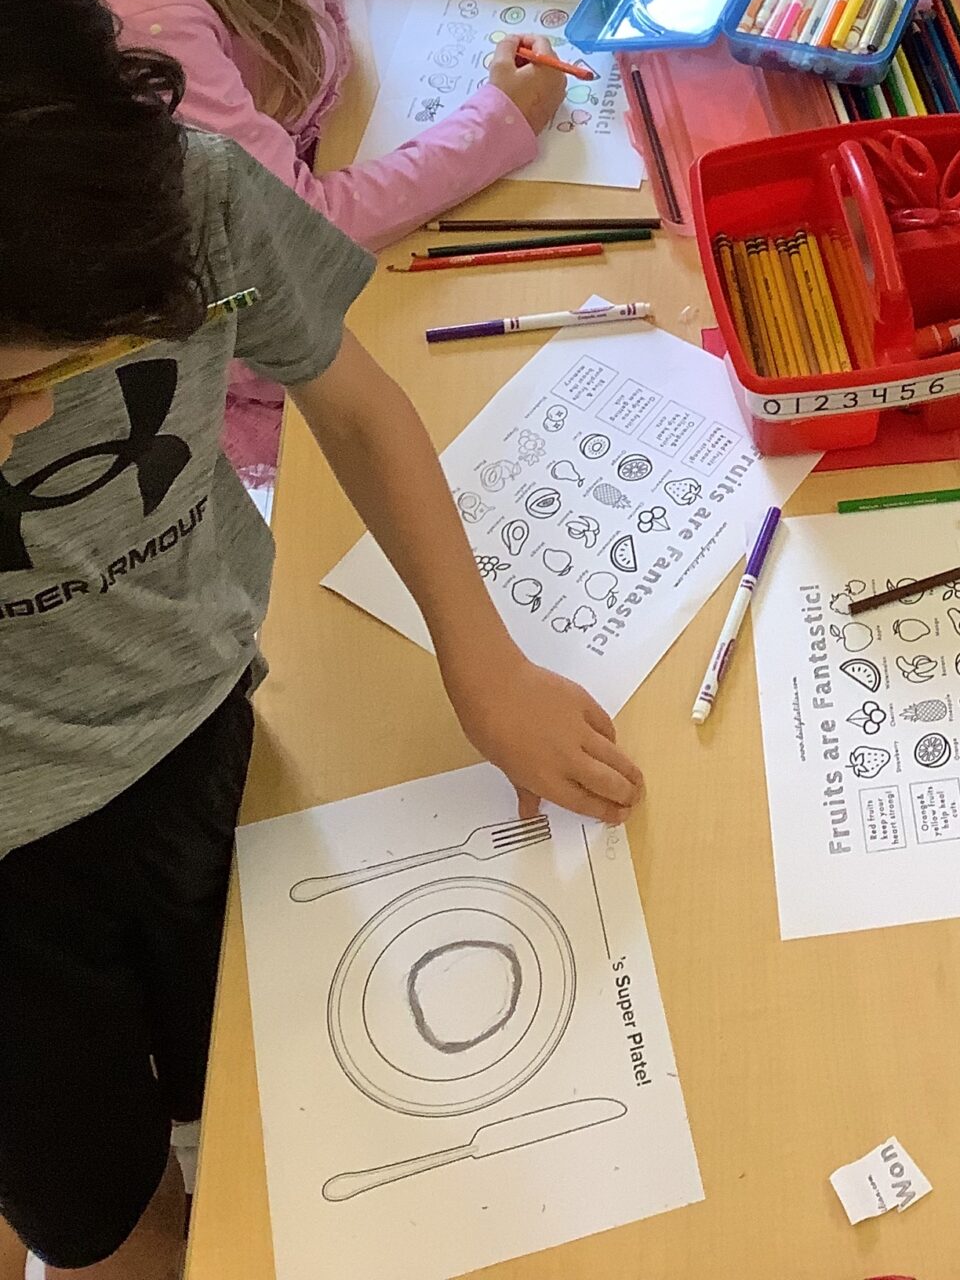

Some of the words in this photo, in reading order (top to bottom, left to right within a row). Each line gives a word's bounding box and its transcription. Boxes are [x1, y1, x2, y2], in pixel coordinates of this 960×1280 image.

[762, 397, 782, 415] 0
[794, 397, 801, 413] 1
[813, 393, 830, 411] 2
[842, 390, 859, 408] 3
[871, 385, 888, 404] 4
[899, 381, 918, 400] 5
[929, 376, 946, 395] 6
[706, 443, 766, 507] Fruits
[676, 504, 712, 543] are
[584, 543, 684, 658] Fantastic!
[797, 584, 835, 709] Fantastic!
[819, 719, 840, 760] are
[819, 769, 853, 854] Fruits
[864, 799, 875, 821] fruits
[877, 797, 888, 816] your
[884, 790, 898, 819] strong!
[916, 793, 930, 831] Orange&
[924, 785, 936, 807] fruits
[935, 790, 946, 809] heal
[867, 823, 878, 840] Red
[878, 819, 891, 839] keep
[888, 822, 900, 845] heart
[928, 808, 942, 836] yellow
[939, 811, 951, 829] help
[610, 956, 627, 972] 's
[610, 973, 639, 1030] Super
[626, 1031, 652, 1087] Plate!
[881, 1144, 916, 1208] Won
